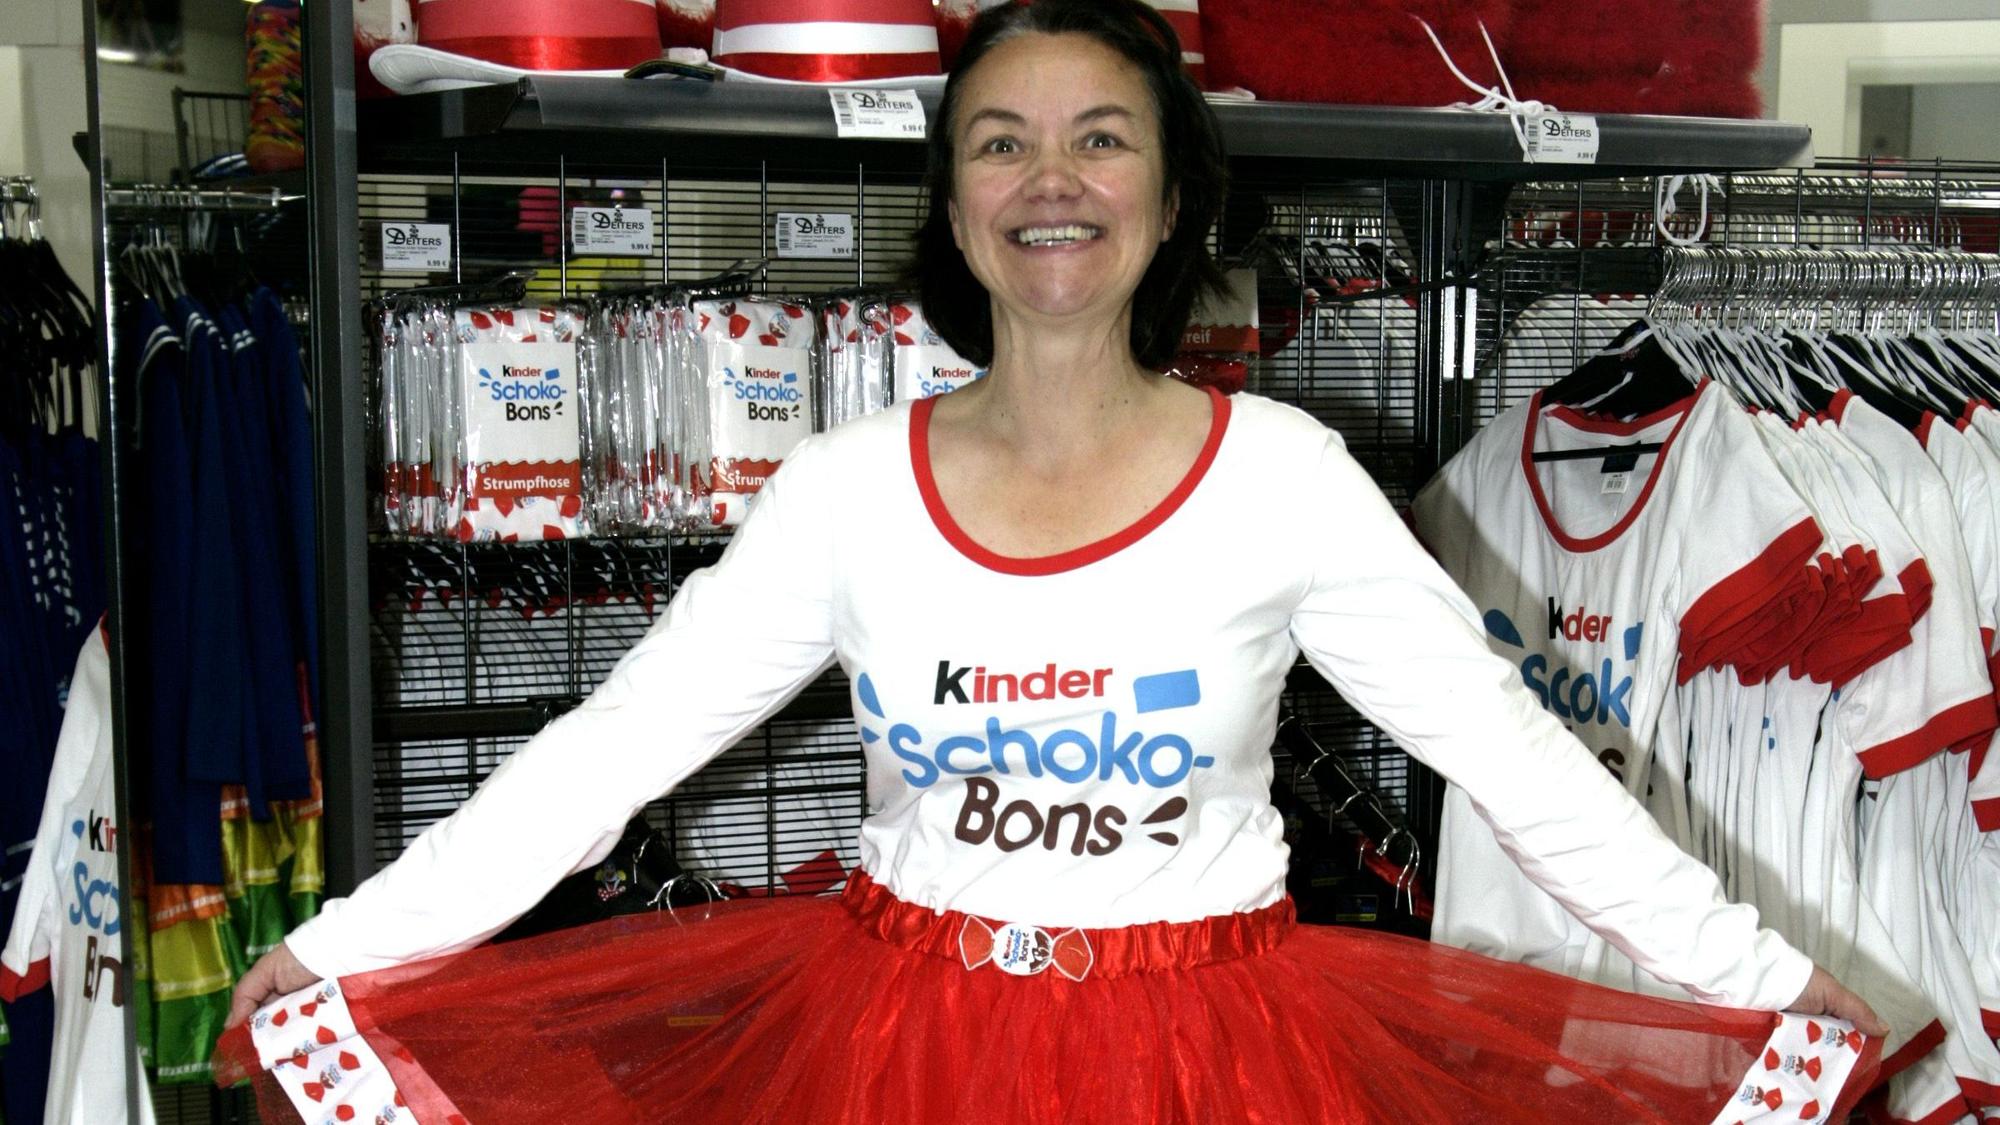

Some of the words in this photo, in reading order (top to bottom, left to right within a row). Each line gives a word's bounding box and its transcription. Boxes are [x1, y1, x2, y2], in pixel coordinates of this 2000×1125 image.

[852, 92, 913, 110] DEITERS
[1542, 119, 1591, 137] DEITERS
[591, 211, 645, 230] DEITERS
[795, 217, 845, 235] DEITERS
[385, 227, 442, 246] DEITERS
[1183, 329, 1211, 344] reif
[491, 380, 567, 401] Schoko-
[735, 380, 803, 402] Schoko-
[921, 381, 957, 398] Sch
[506, 402, 551, 421] Bons
[748, 402, 789, 422] Bons
[483, 475, 571, 492] Strumpfhose
[727, 471, 768, 486] Strum
[888, 710, 1214, 788] Schoko-
[955, 777, 1126, 856] Bons
